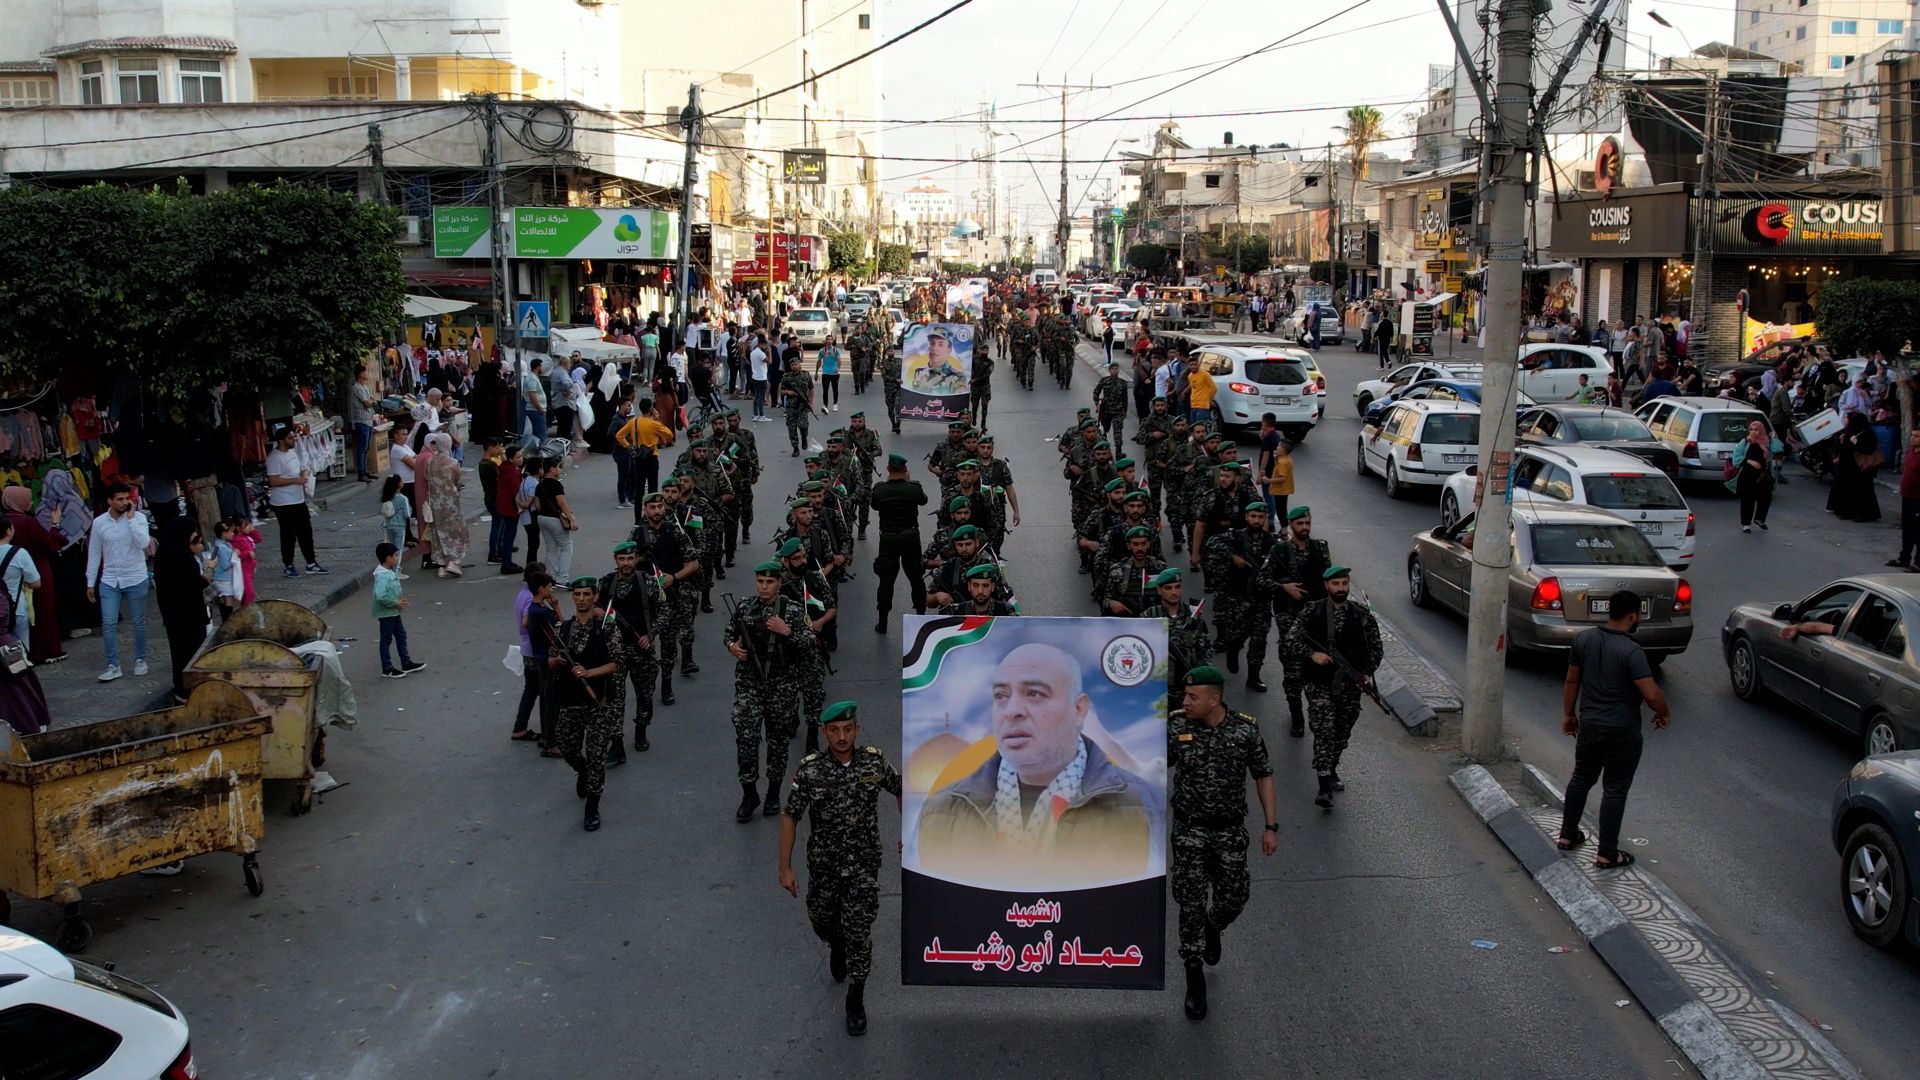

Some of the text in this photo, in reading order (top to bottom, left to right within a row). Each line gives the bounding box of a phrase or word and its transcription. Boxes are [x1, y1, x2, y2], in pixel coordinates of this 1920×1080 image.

[461, 214, 479, 223] شركة
[520, 214, 569, 224] شركة حرز الله
[1590, 206, 1630, 226] COUSINS
[520, 227, 557, 236] للاتصالات
[1802, 230, 1819, 239] Bar
[1821, 230, 1828, 239] &
[776, 237, 809, 249] شورما
[617, 245, 639, 254] جوال
[1006, 898, 1061, 927] الشهيد
[923, 930, 1143, 972] عماد أبو رشيد
